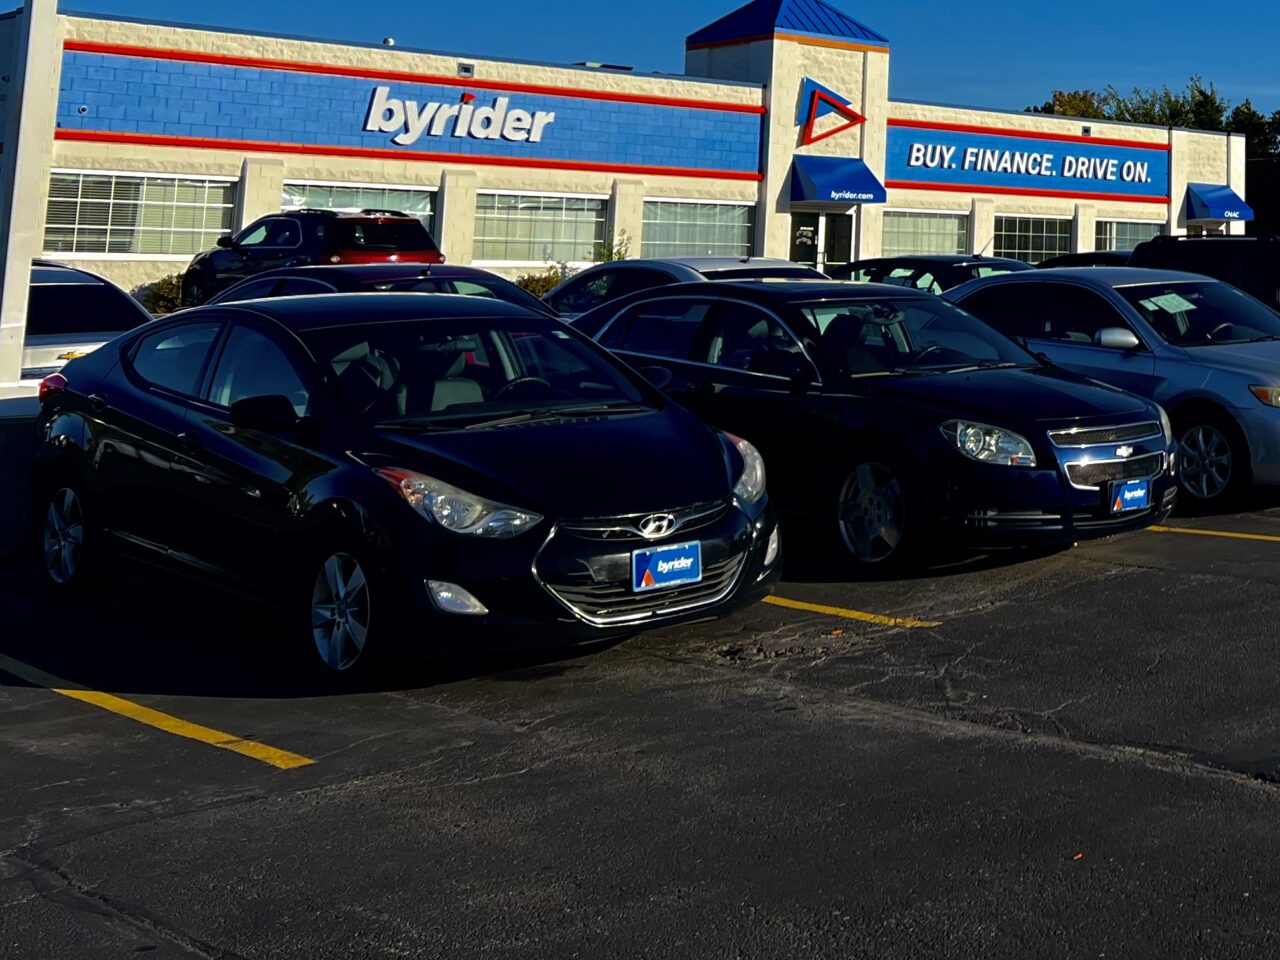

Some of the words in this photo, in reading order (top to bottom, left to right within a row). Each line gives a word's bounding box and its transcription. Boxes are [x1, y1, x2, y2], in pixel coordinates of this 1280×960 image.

[363, 86, 555, 145] byrider
[909, 143, 956, 169] BUY.
[964, 148, 1057, 177] FINANCE.
[1063, 156, 1118, 180] DRIVE
[1122, 160, 1152, 183] ON.
[831, 190, 874, 200] byrider.com
[657, 557, 694, 574] byrider
